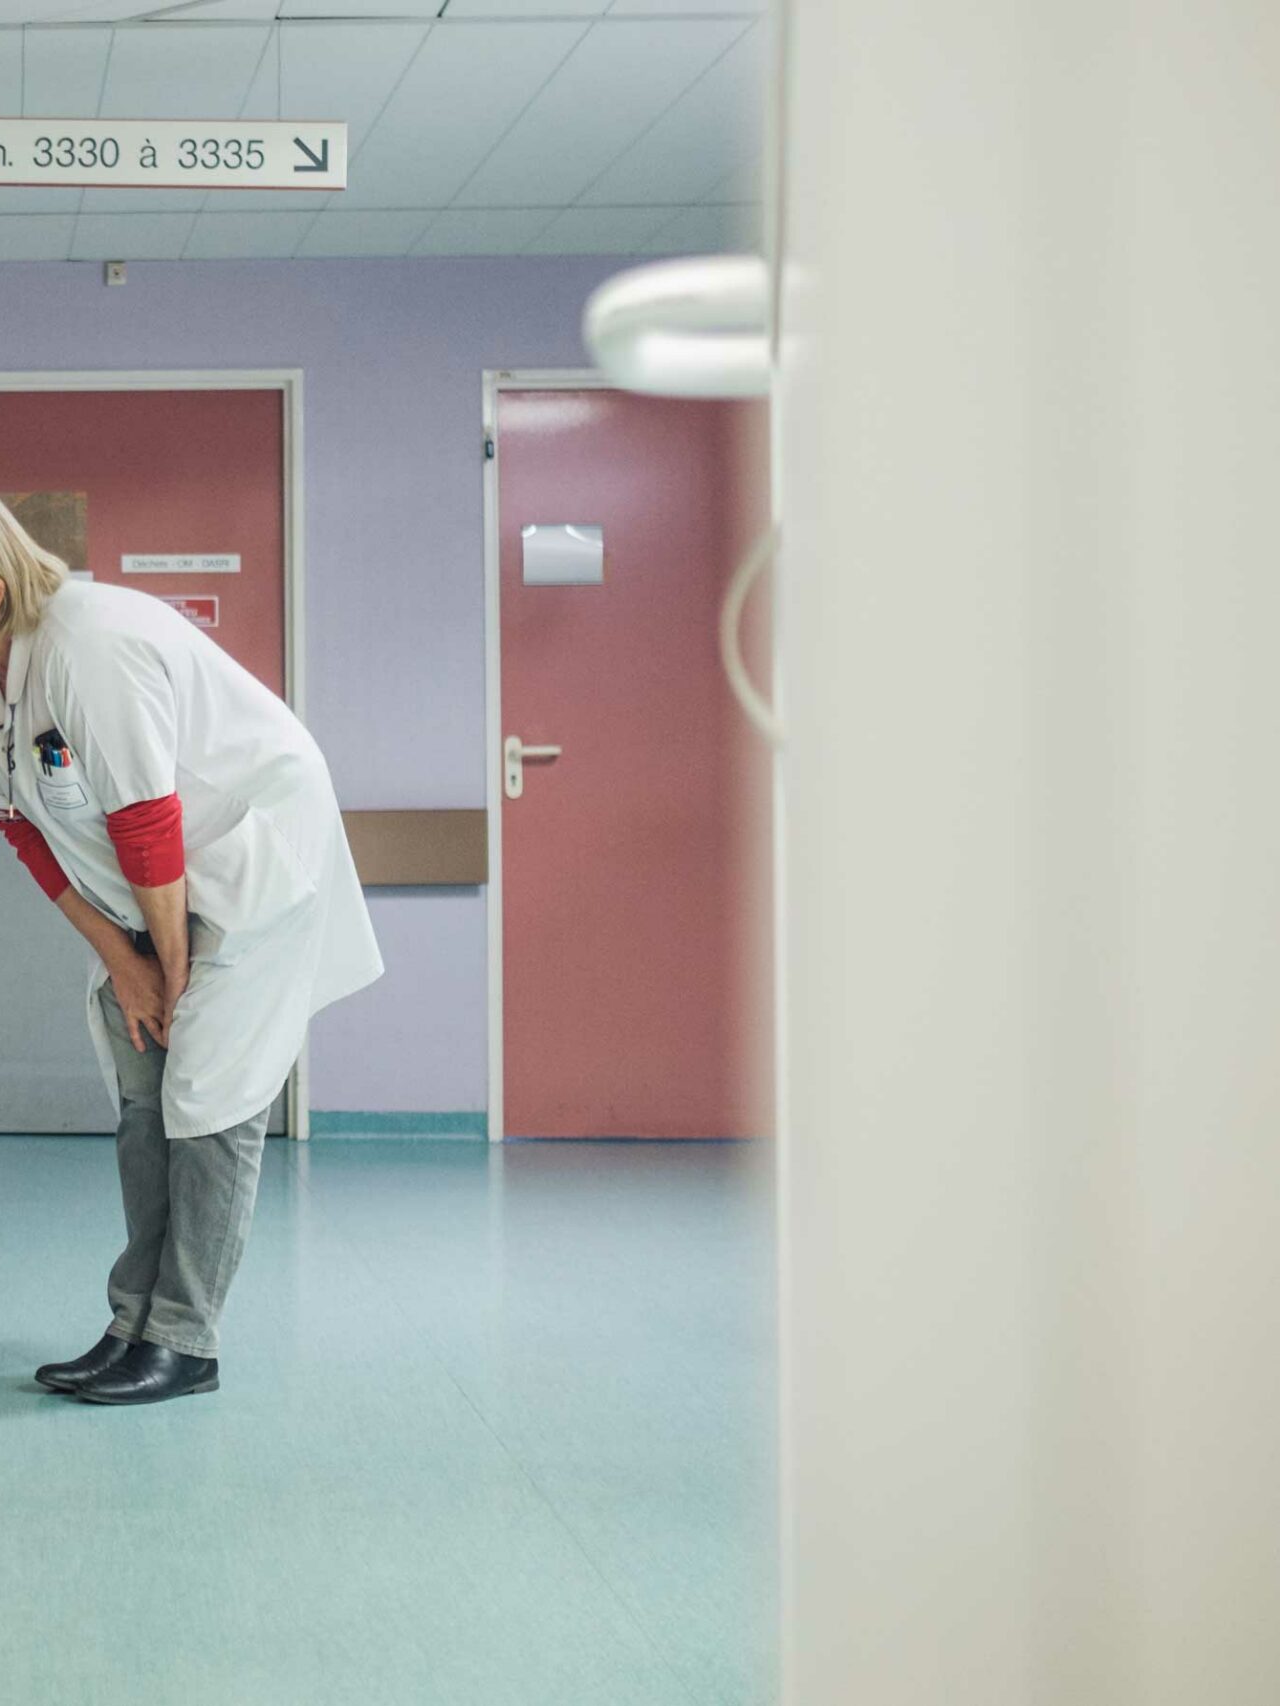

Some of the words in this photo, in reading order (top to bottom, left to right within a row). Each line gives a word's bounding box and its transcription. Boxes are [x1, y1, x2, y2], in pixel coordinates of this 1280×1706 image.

[32, 137, 120, 168] 3330
[139, 138, 159, 169] à
[178, 139, 265, 170] 3335
